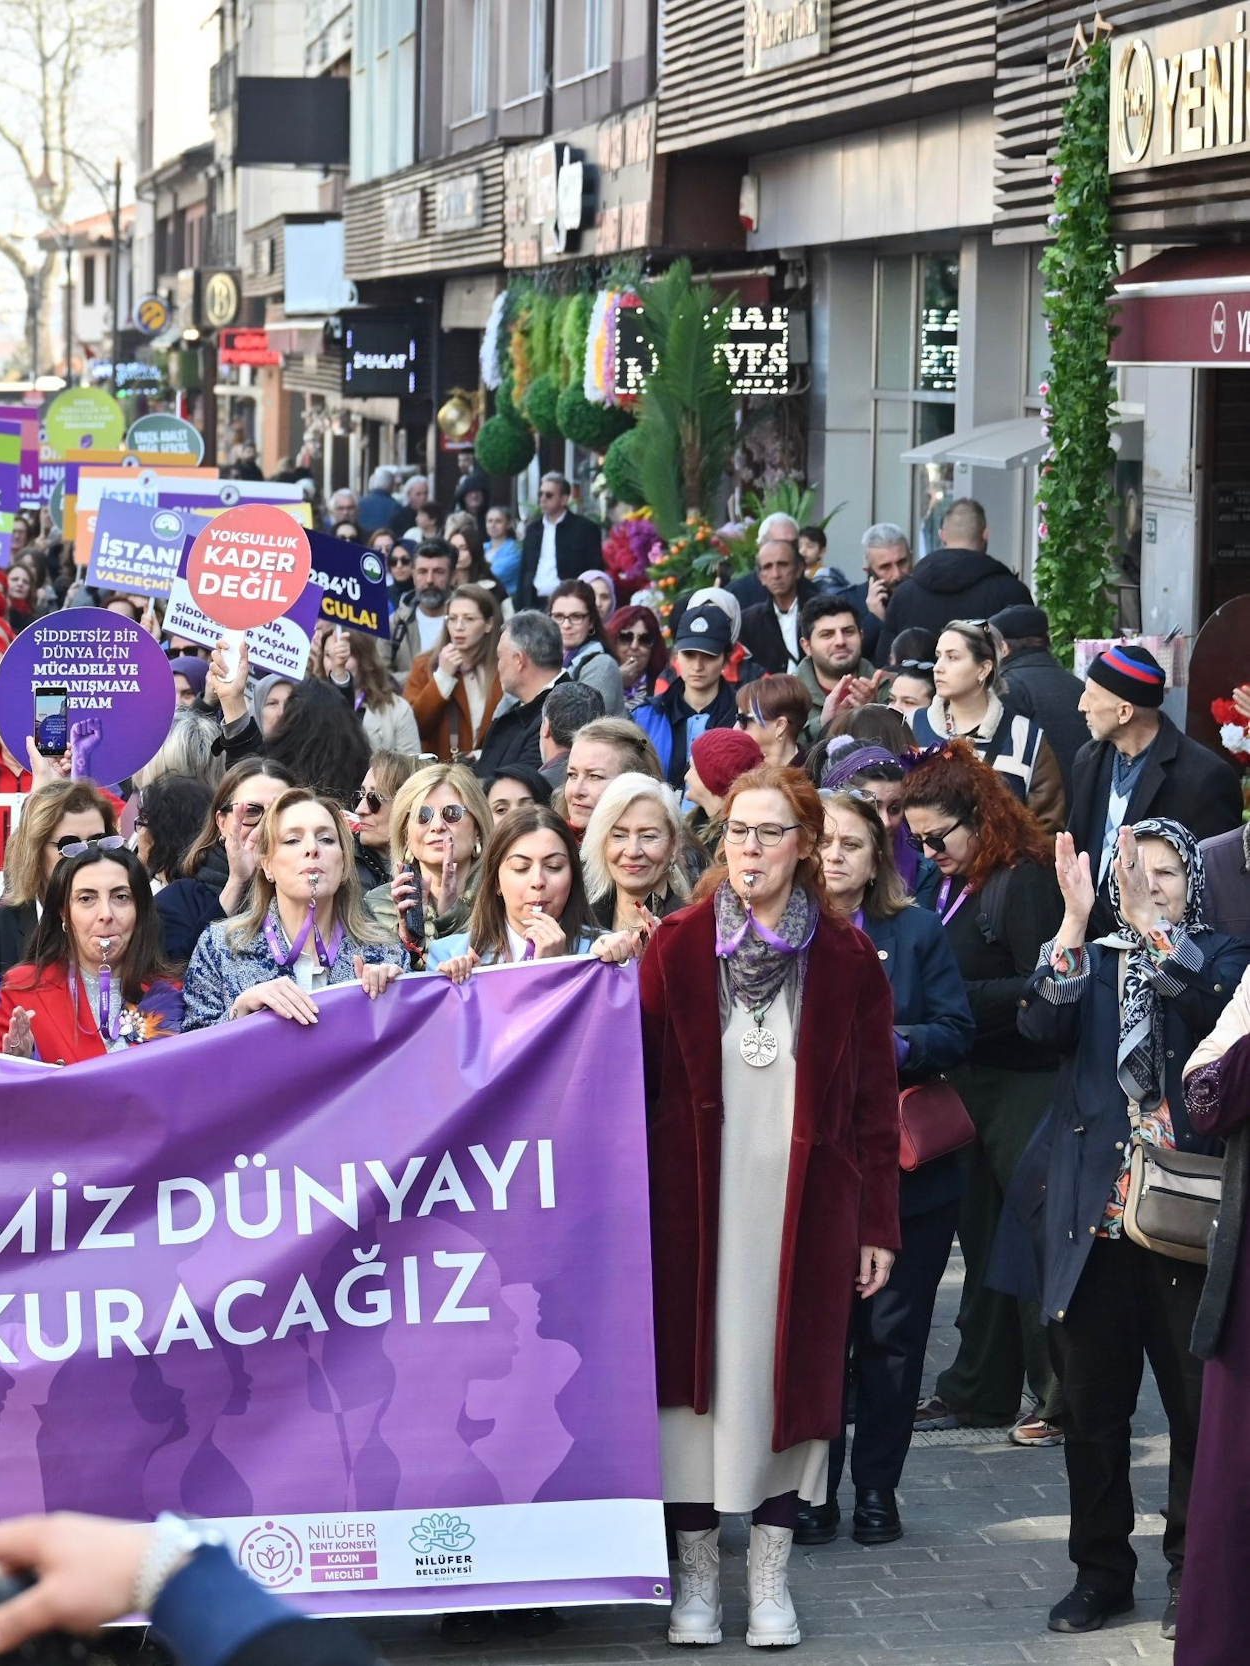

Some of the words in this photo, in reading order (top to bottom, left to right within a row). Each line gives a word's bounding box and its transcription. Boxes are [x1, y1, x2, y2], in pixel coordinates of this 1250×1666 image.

[1156, 10, 1250, 156] YENİ
[210, 529, 299, 549] YOKSULLUK
[100, 532, 179, 566] İSTAN
[97, 556, 177, 577] SÖZLEŞMES
[204, 545, 295, 573] KADER
[197, 571, 289, 603] DEĞİL
[322, 597, 378, 630] GULA!
[34, 628, 111, 645] ŞİDDETSİZ
[114, 628, 138, 642] BİR
[170, 615, 223, 640] BİRLİKTE
[257, 633, 300, 656] YAŞAMI
[42, 645, 94, 659] DÜNYA
[98, 645, 129, 661] İÇİN
[33, 661, 116, 676] MÜCADELE
[118, 664, 138, 676] VE
[67, 697, 112, 709] EVAM
[156, 1138, 556, 1246] DÜNYAYI
[308, 1521, 376, 1539] NİLÜFER
[309, 1542, 332, 1551] KENT
[335, 1539, 377, 1550] KONSEYİ
[327, 1554, 360, 1564] KADIN
[415, 1555, 472, 1566] NİLÜFER
[325, 1568, 364, 1580] MECLİSİ
[416, 1565, 472, 1576] BELEDİYESİ
